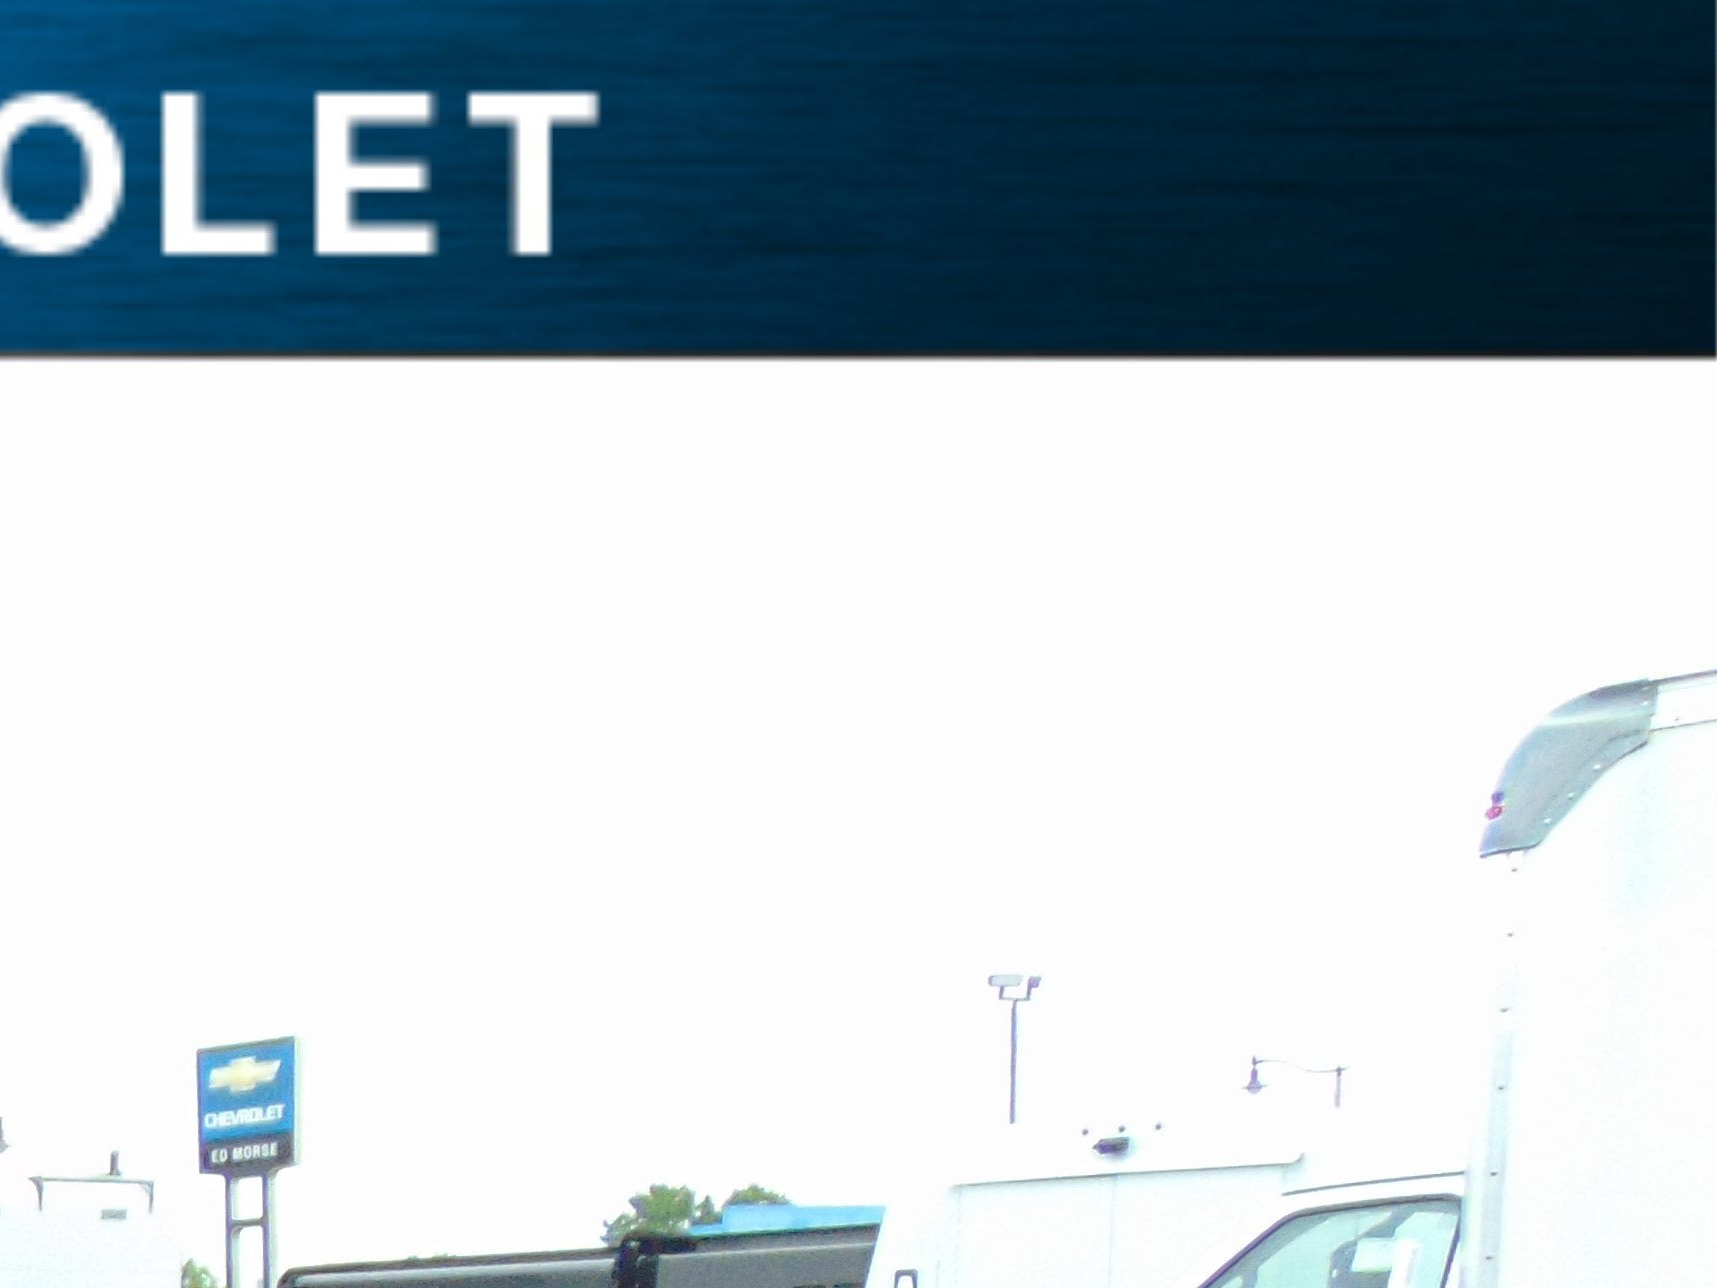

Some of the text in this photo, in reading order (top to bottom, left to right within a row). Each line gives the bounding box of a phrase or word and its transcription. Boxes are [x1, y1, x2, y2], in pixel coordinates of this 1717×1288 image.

[204, 1103, 285, 1128] CHEVROLET
[210, 1142, 278, 1163] ED MORSE
